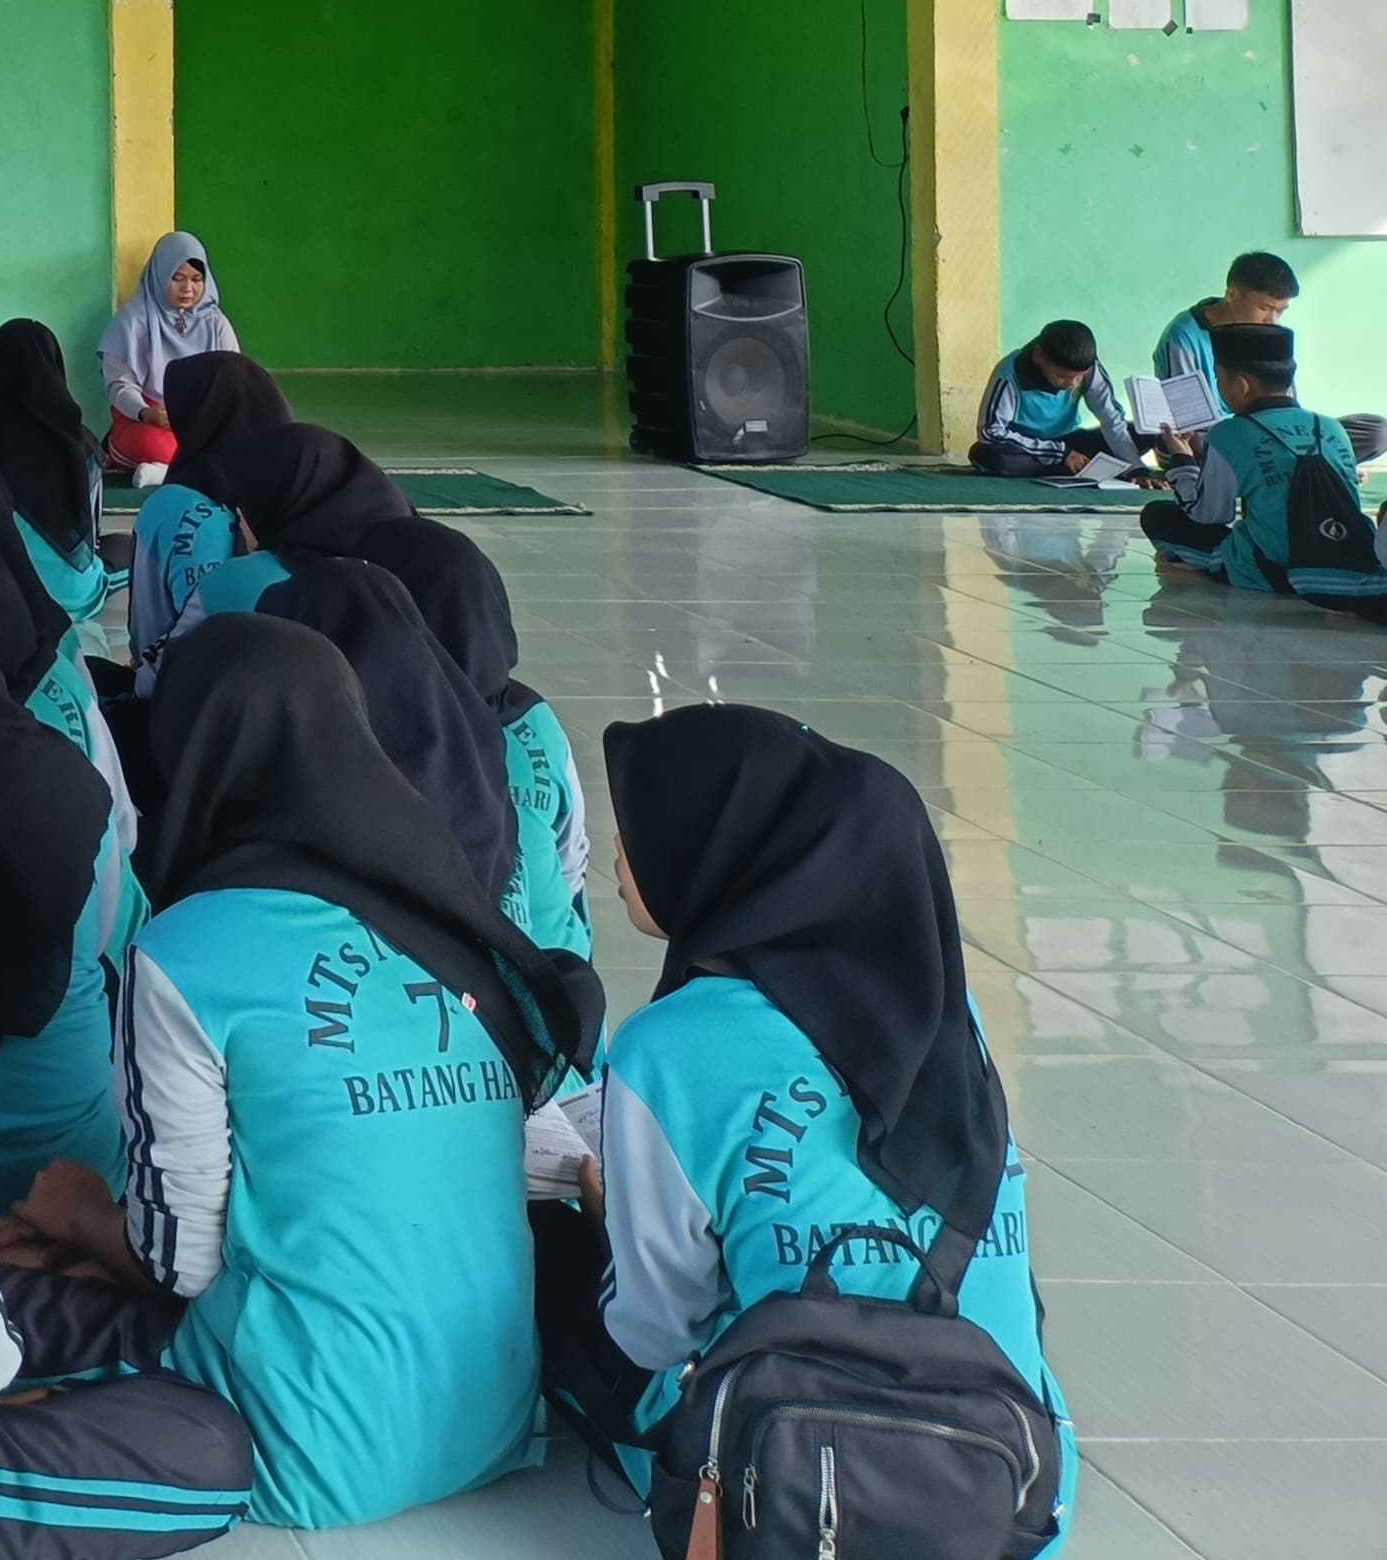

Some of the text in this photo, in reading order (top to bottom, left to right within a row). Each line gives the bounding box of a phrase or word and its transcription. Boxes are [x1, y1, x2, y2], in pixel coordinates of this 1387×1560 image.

[174, 502, 213, 557] MTS
[41, 679, 83, 737] ERI
[512, 721, 551, 787] ERI
[305, 942, 371, 1054] MTS
[403, 980, 449, 1053] 7
[343, 1059, 522, 1115] BATANG HA
[743, 1076, 828, 1204] MTS
[976, 1211, 1026, 1258] ARI
